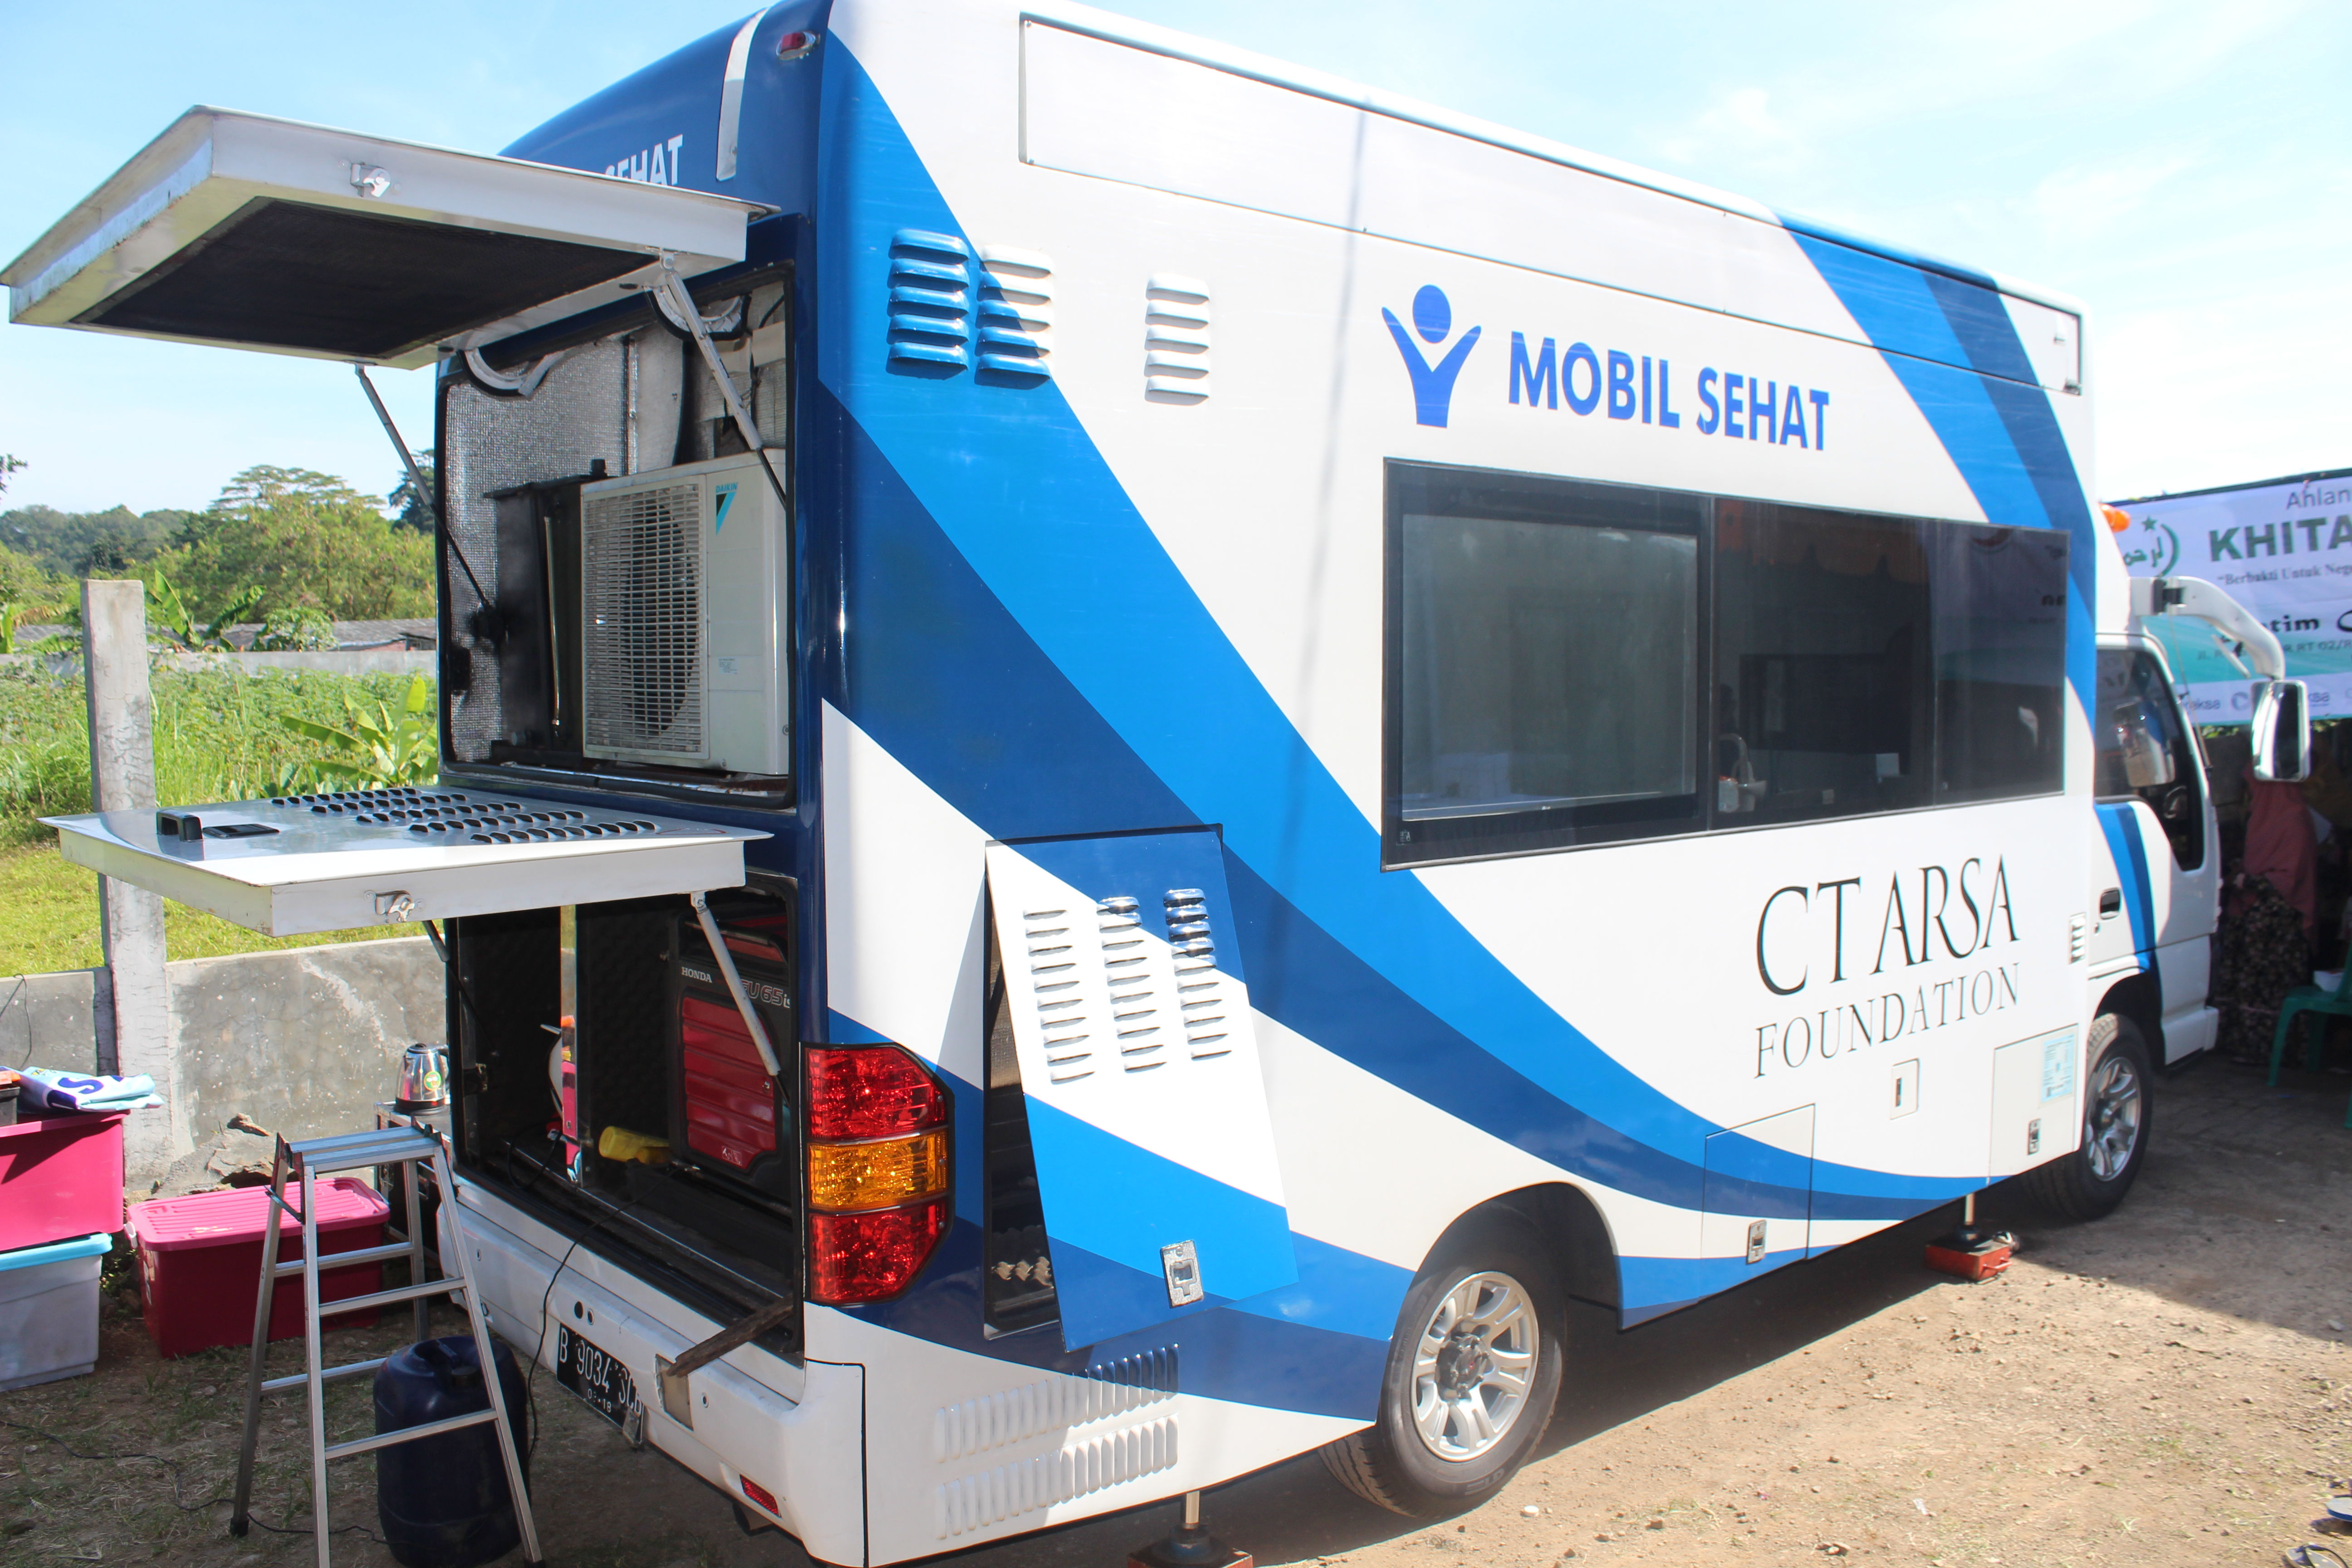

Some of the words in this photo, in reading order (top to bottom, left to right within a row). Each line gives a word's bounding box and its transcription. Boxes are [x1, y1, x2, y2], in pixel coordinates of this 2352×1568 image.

[605, 134, 683, 185] HAT
[1509, 331, 1680, 429] MOBIL
[1696, 367, 1829, 451] SEHAT
[715, 482, 738, 493] DAIKIN
[2286, 487, 2351, 510] Ahlan
[2209, 514, 2352, 562] KHITA
[1756, 877, 1861, 996] CT
[1869, 853, 2021, 975] ARSA
[681, 966, 712, 984] HONDA
[1754, 962, 2020, 1079] FOUNDATION
[559, 1327, 568, 1363] B
[577, 1340, 611, 1393] 9034
